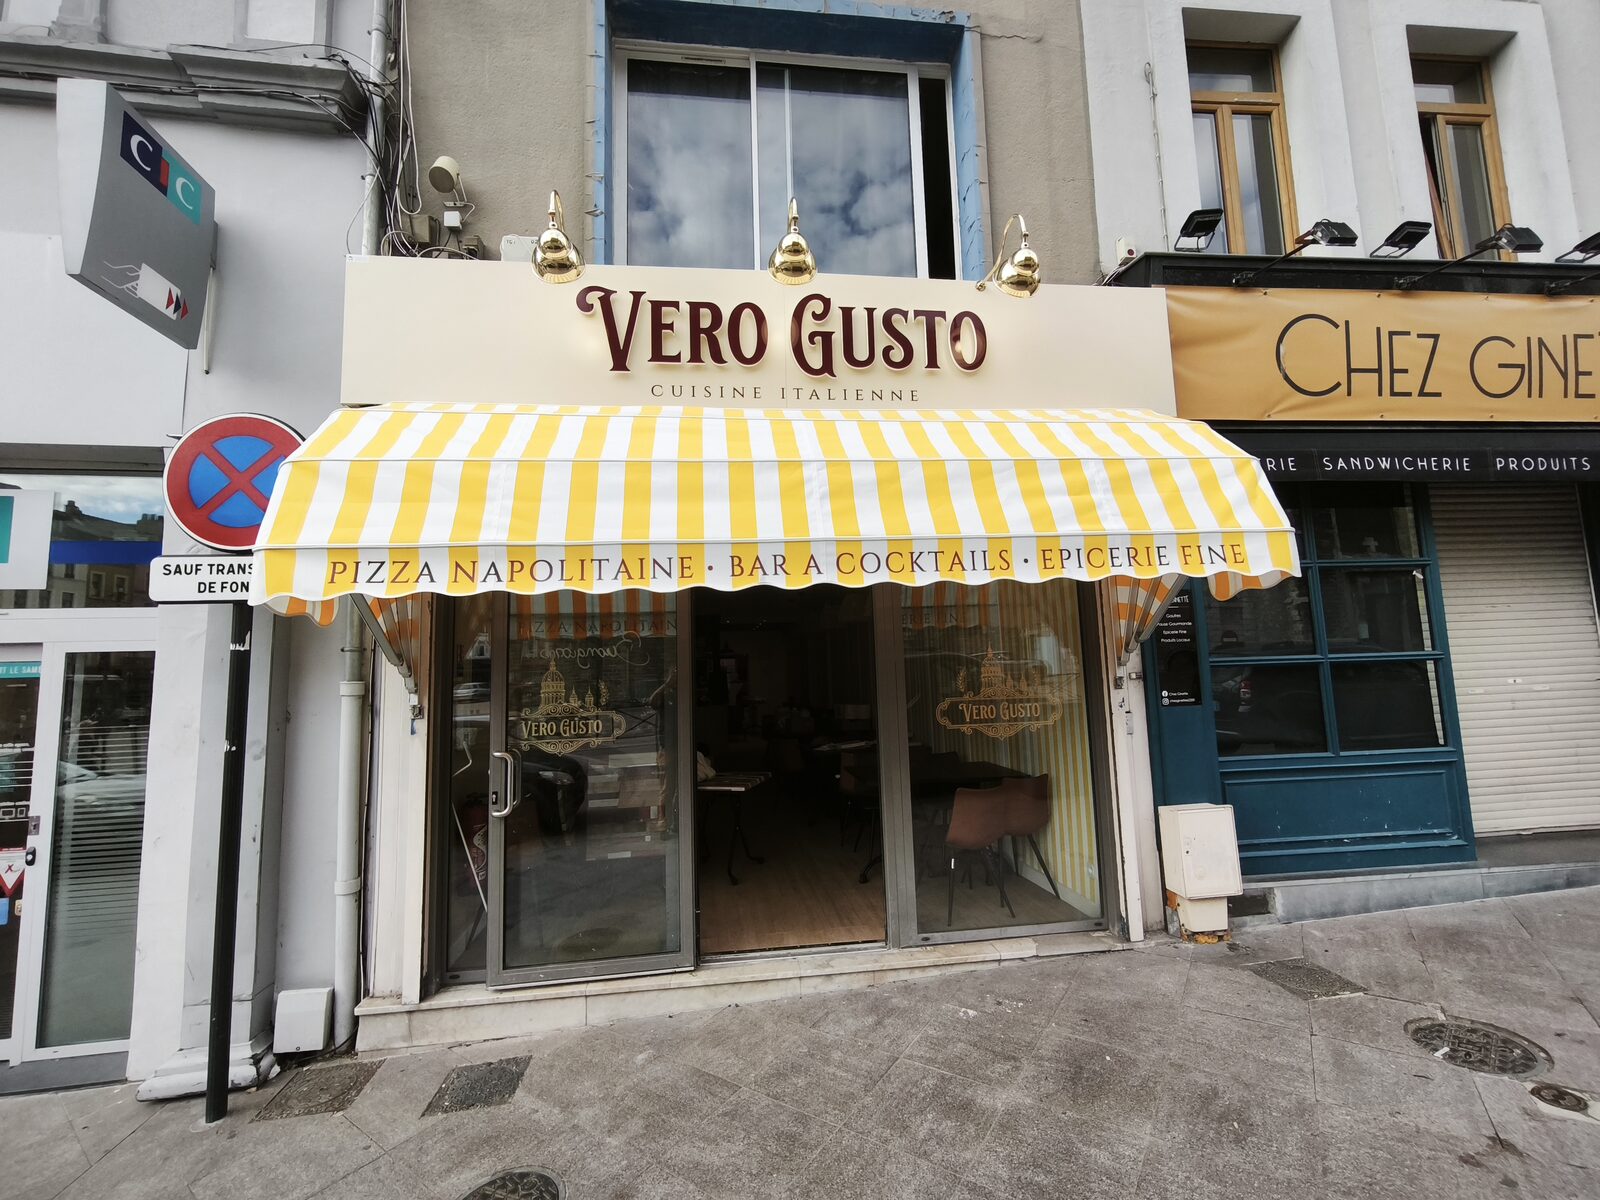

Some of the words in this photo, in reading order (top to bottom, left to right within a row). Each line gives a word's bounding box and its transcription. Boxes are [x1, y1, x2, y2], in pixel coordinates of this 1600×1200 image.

[130, 134, 195, 210] CIC
[576, 285, 769, 372] VERO
[790, 293, 988, 378] GUSTO
[1275, 313, 1443, 398] CHEZ
[1469, 331, 1600, 399] GINE
[650, 384, 762, 399] CUISINE
[780, 386, 920, 401] ITALIENNE
[1260, 457, 1297, 471] RIE
[1322, 456, 1471, 472] SANDWICHERIE
[1496, 456, 1591, 471] PRODUITS
[162, 563, 203, 576] SAUF
[328, 560, 437, 584] PIZZA
[451, 555, 694, 583] NAPOLITAINE
[729, 553, 791, 578] BAR
[803, 554, 823, 575] A
[835, 549, 1011, 574] COCKTAILS
[1041, 545, 1170, 570] EPICERIE
[1181, 543, 1246, 566] FINE
[197, 581, 217, 593] DE
[221, 581, 250, 593] FON
[959, 703, 996, 722] VERO
[1000, 702, 1040, 720] GUSTO
[520, 720, 557, 739] VERO
[560, 719, 602, 737] GUSTO
